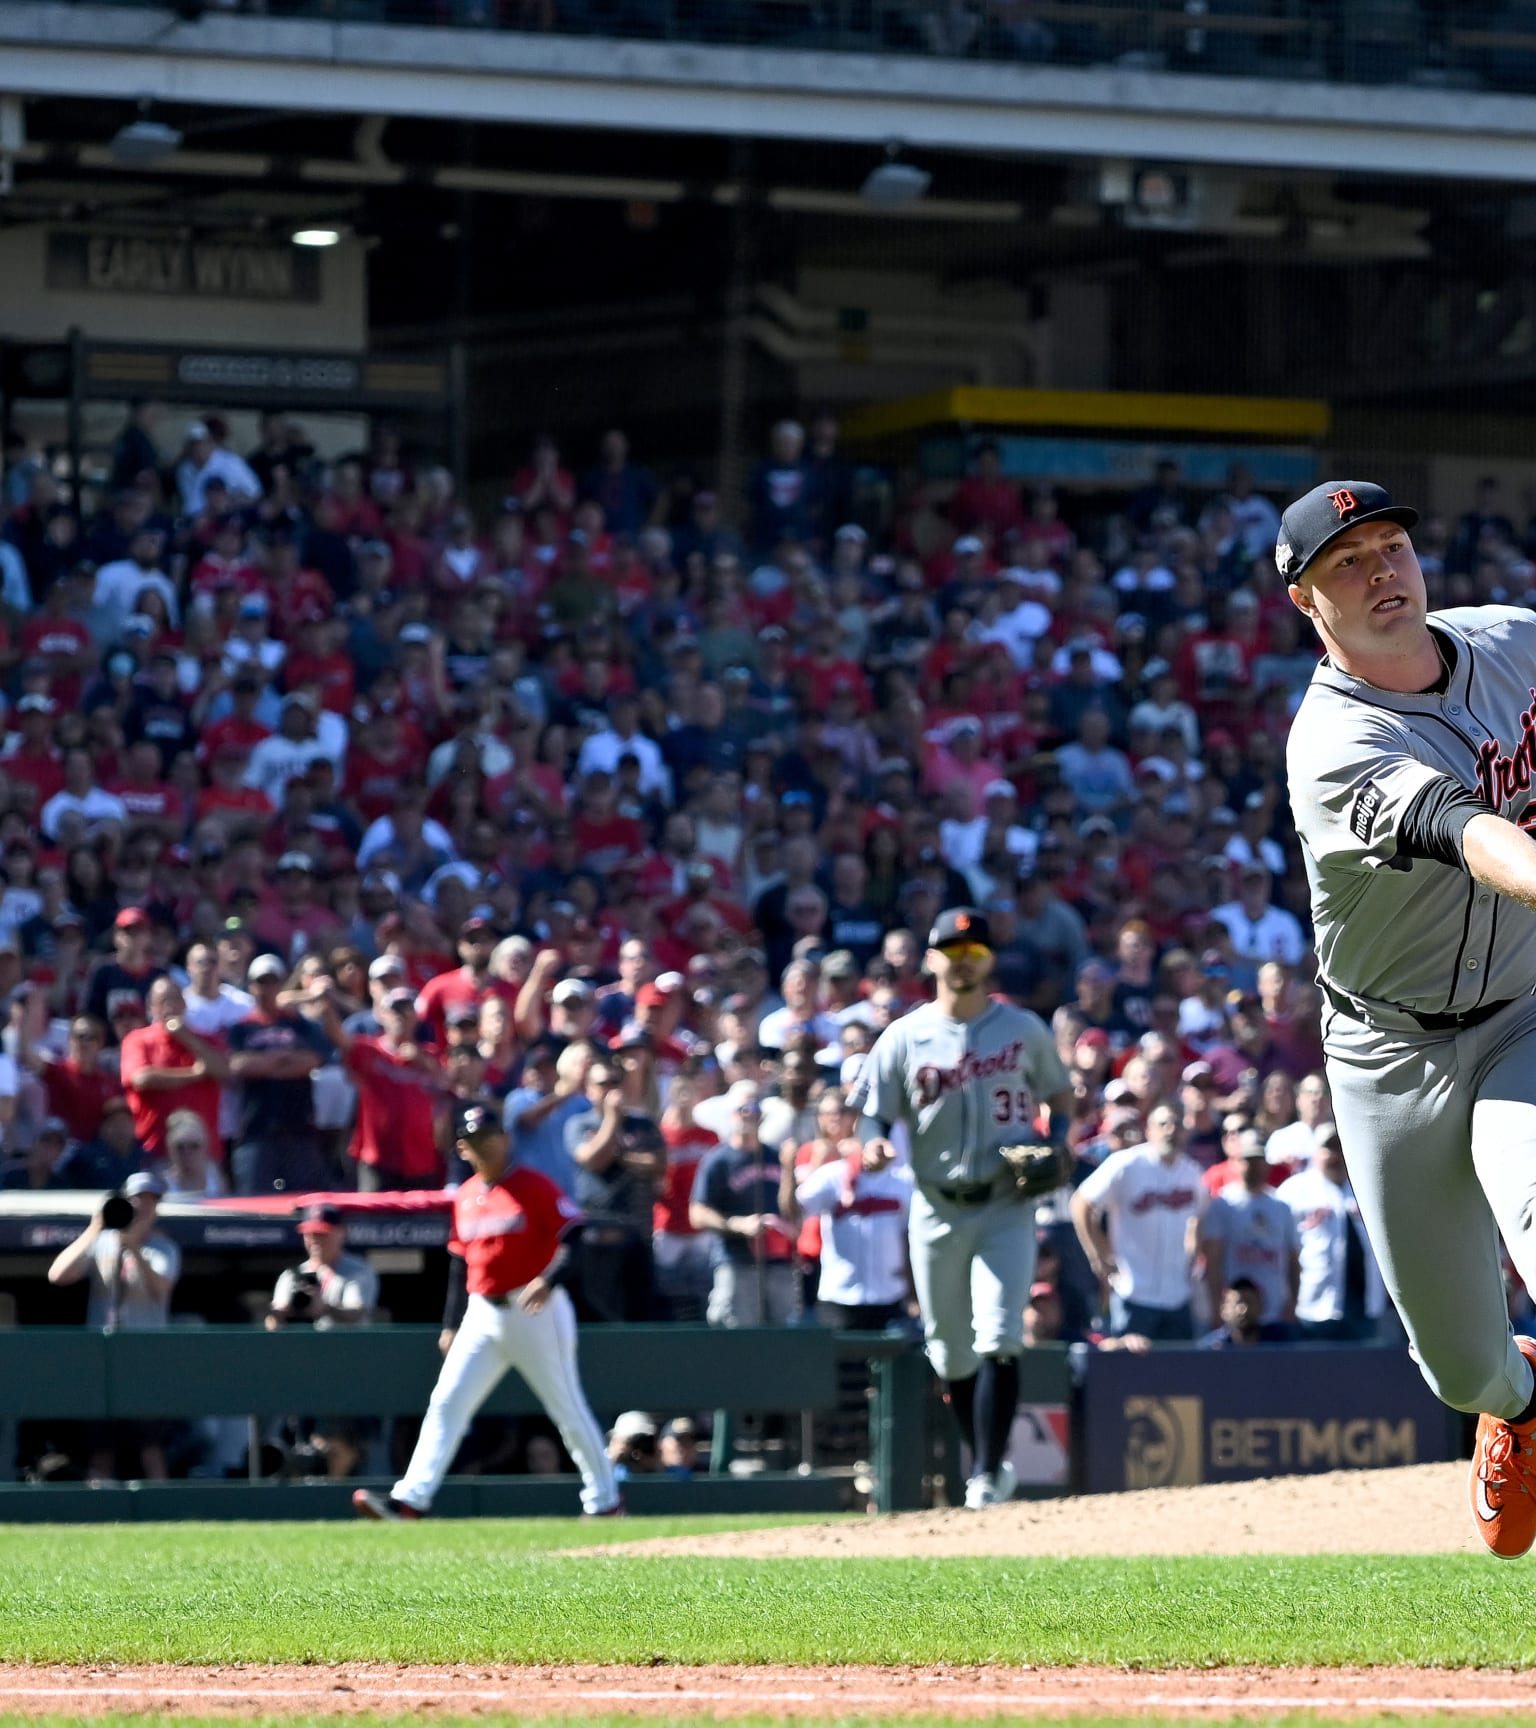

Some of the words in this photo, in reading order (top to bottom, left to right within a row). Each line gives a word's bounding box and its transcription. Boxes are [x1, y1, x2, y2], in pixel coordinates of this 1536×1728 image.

[1327, 487, 1359, 520] D
[1355, 788, 1379, 840] meijer
[916, 1039, 1024, 1104] Detroit
[1211, 1417, 1418, 1469] BETMGM
